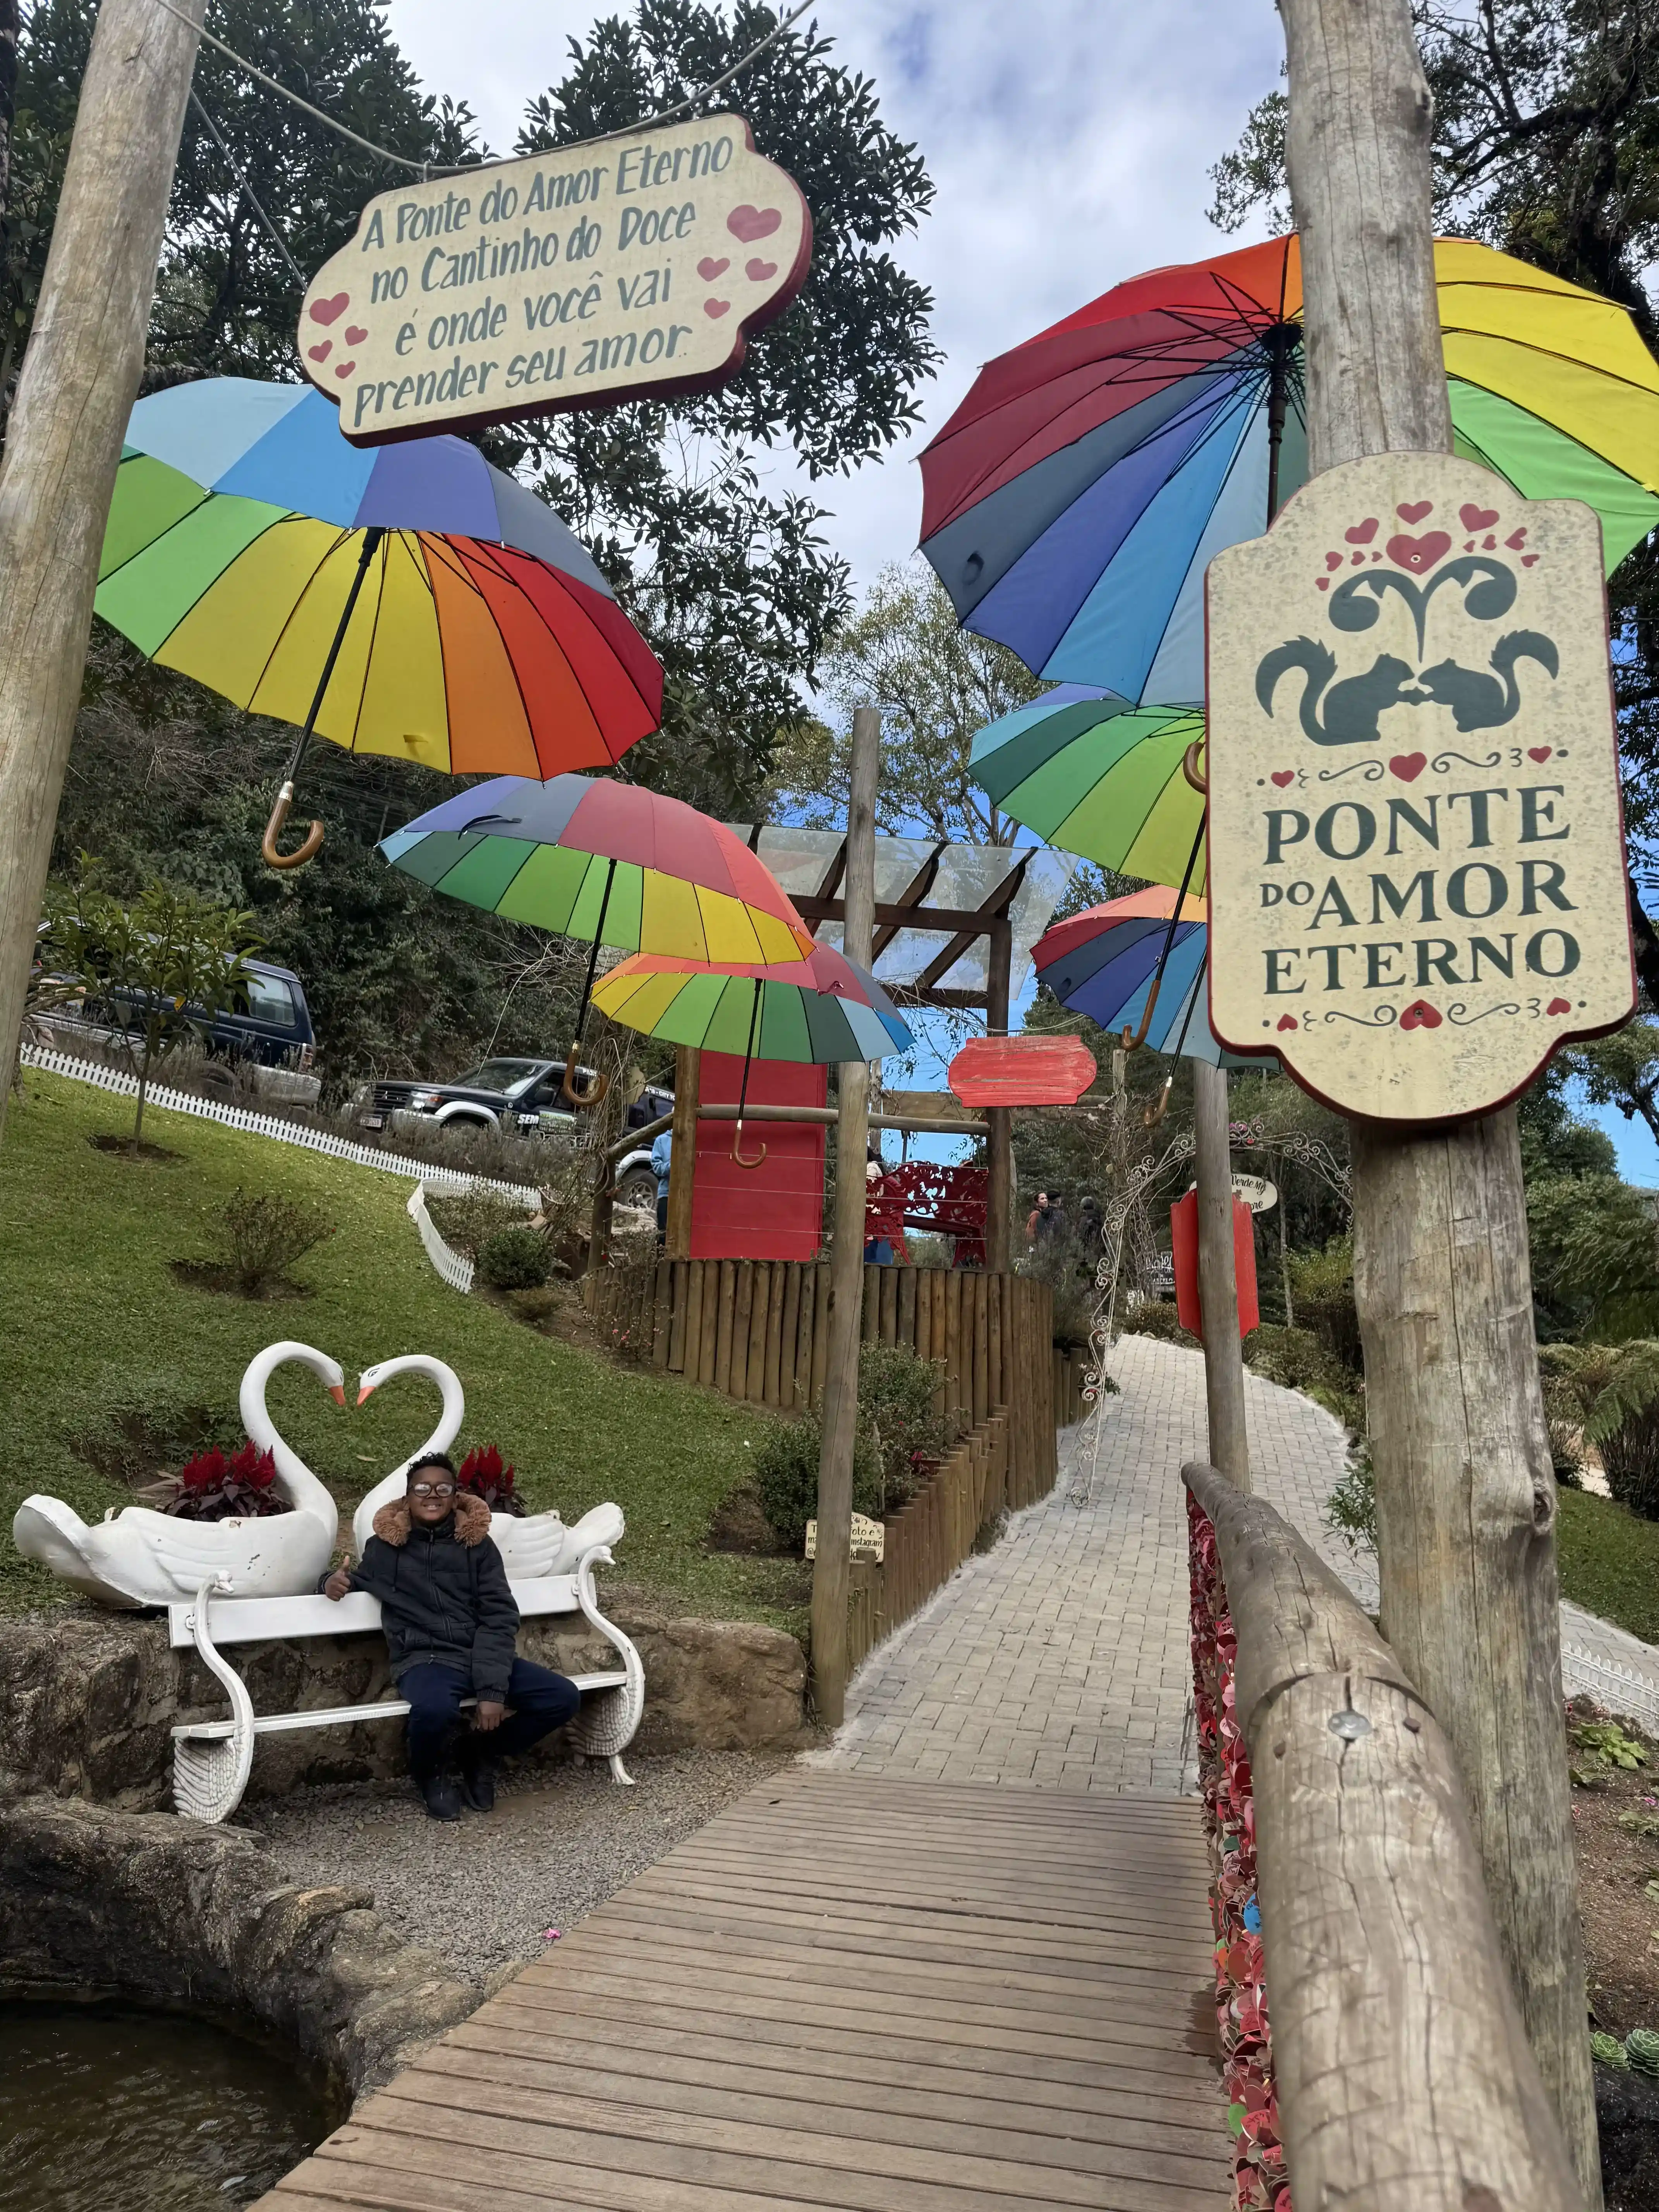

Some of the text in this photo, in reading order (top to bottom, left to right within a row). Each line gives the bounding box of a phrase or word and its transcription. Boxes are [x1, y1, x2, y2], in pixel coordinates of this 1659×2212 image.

[362, 137, 732, 252] A Ponte do Amor Eterno
[371, 202, 696, 304] no Cantinho do Doce
[396, 259, 672, 355] é onde você vai
[505, 340, 565, 388] seu
[1263, 785, 1570, 865] PONTE
[1260, 860, 1578, 930] DO AMOR
[1262, 929, 1580, 994] ETERNO
